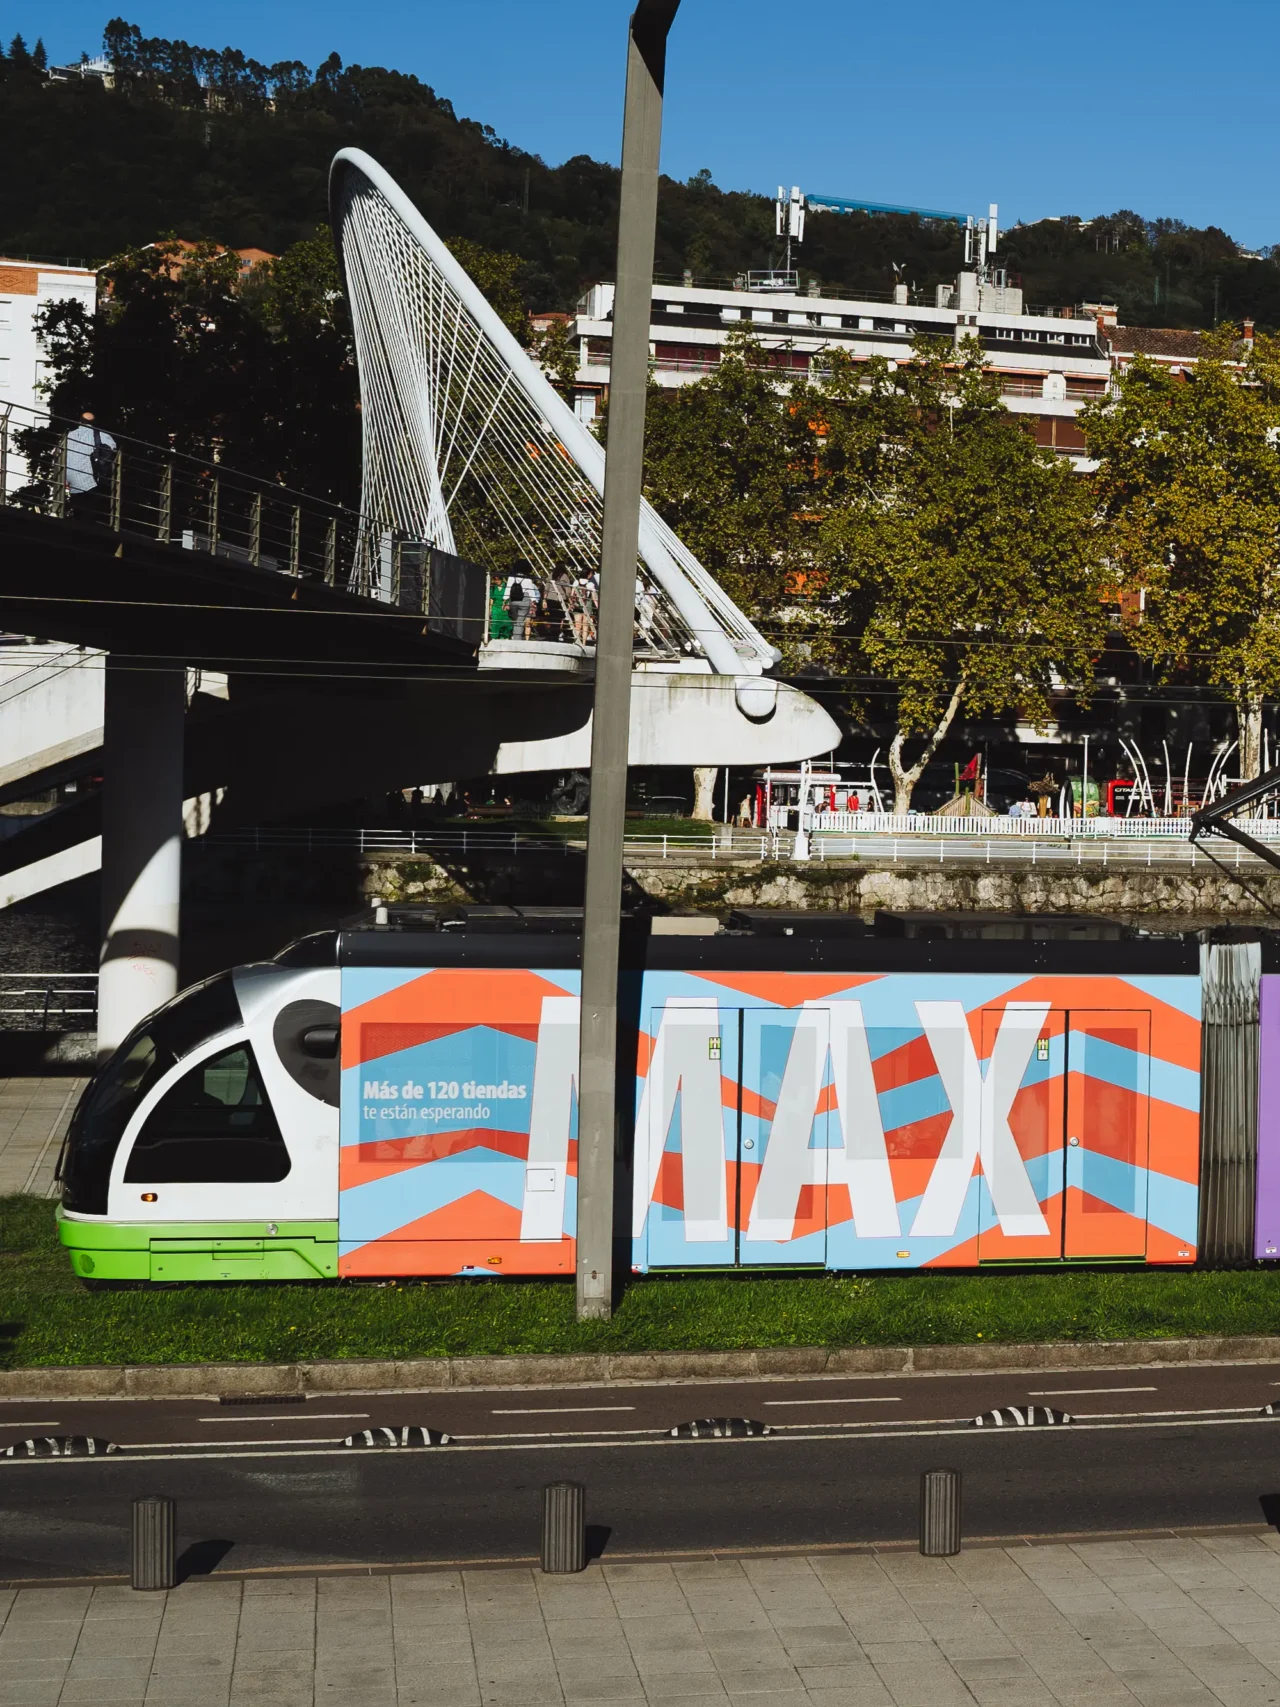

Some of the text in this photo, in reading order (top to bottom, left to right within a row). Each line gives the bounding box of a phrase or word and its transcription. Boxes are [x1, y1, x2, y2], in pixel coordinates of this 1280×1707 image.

[363, 1080, 527, 1099] Más de 120 tiendas
[363, 1103, 491, 1123] te están esperando
[519, 995, 1053, 1243] MAX
